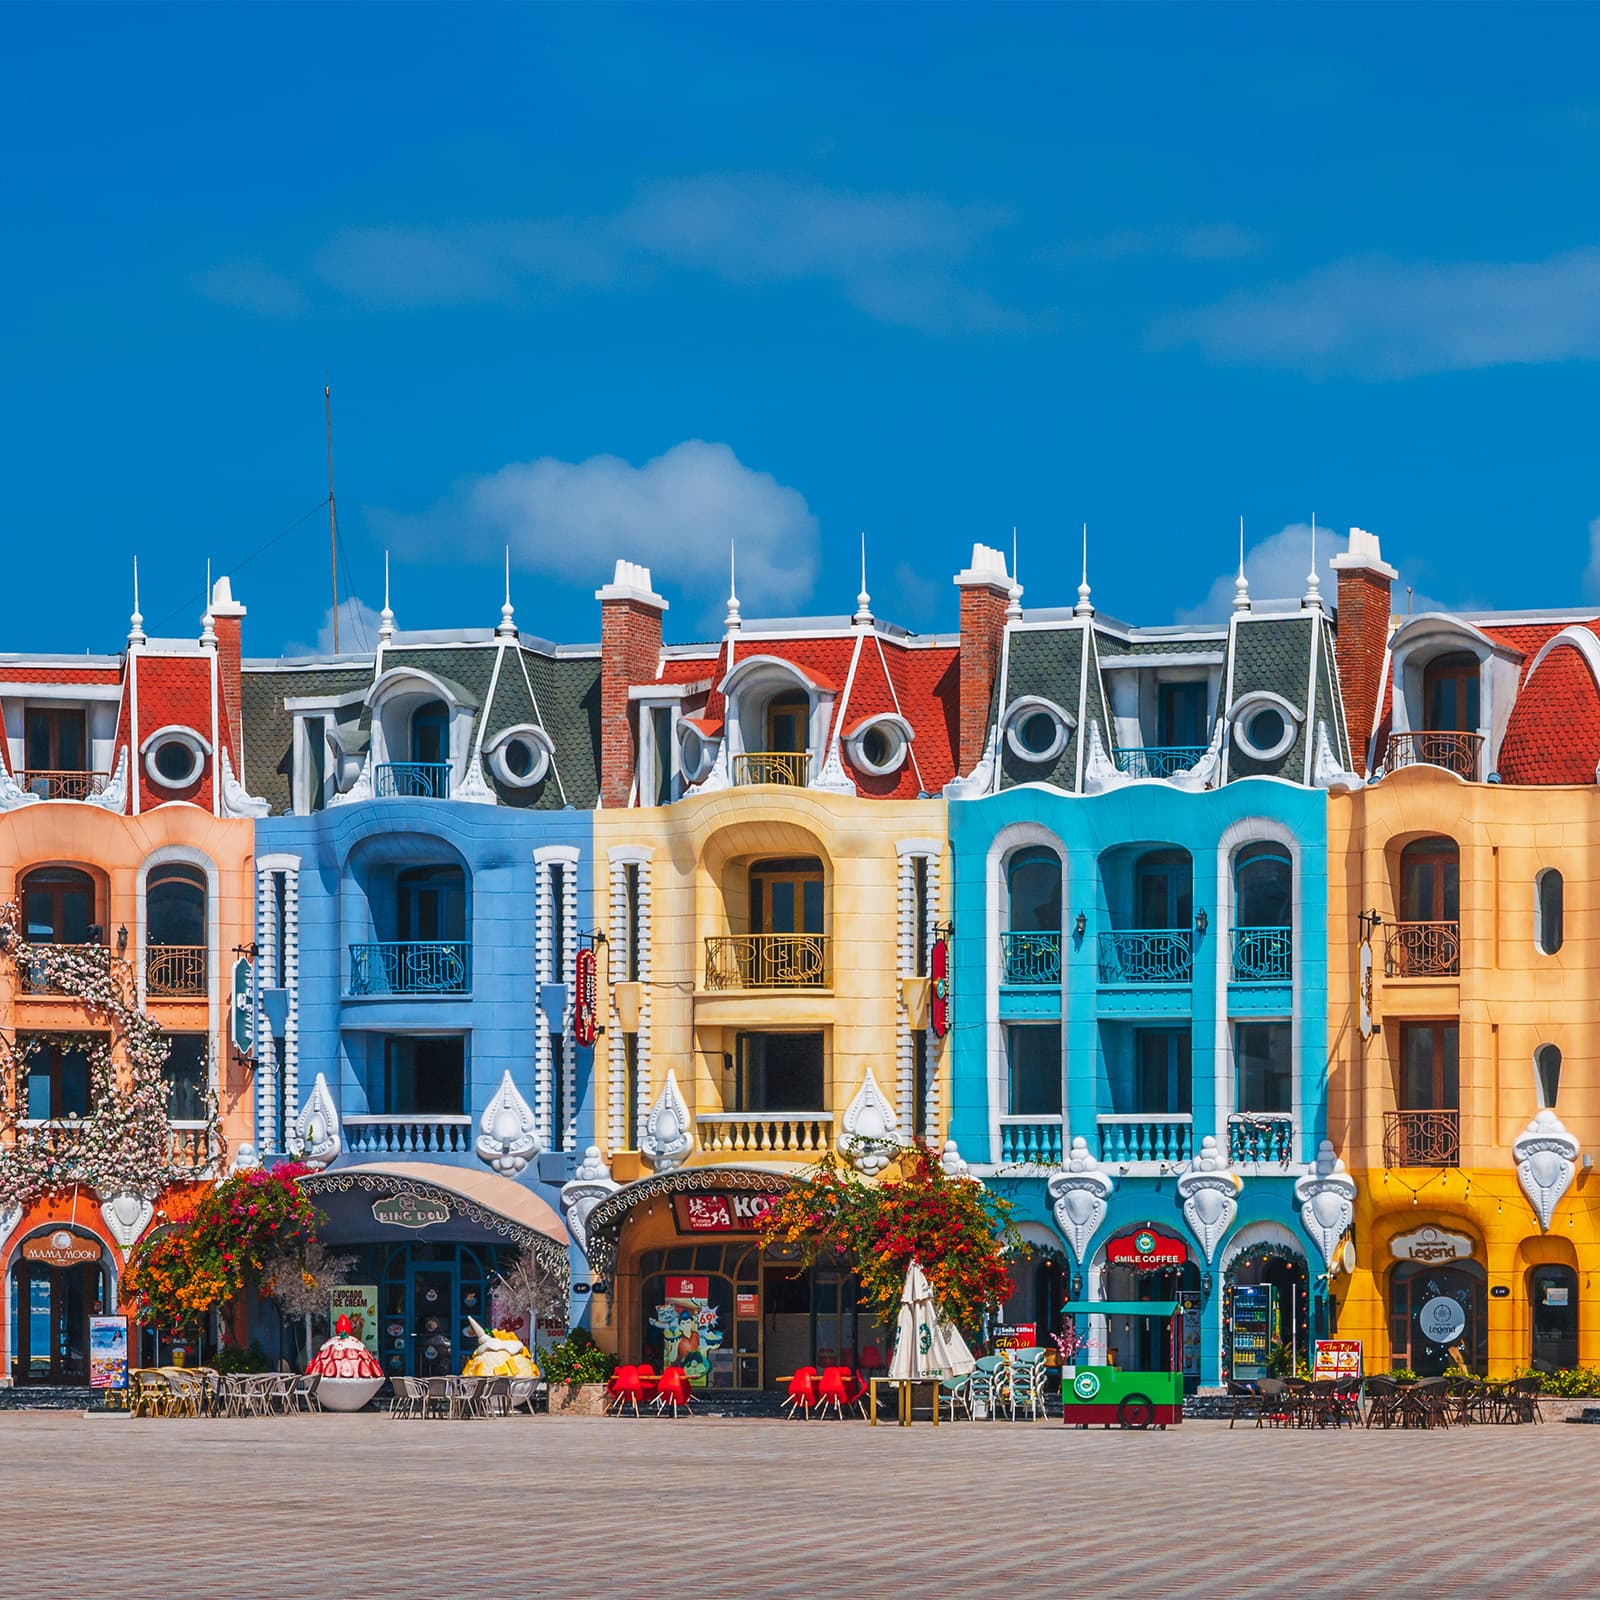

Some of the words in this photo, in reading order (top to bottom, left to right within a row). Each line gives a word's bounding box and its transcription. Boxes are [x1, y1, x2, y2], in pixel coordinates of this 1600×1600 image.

[379, 1212, 412, 1221] BING
[416, 1211, 445, 1220] DOU
[28, 1249, 63, 1259] MAMA
[64, 1250, 96, 1259] MOON
[1408, 1245, 1456, 1260] Legend
[1114, 1255, 1142, 1263] SMILE
[1142, 1255, 1179, 1263] COFFEE
[333, 1299, 343, 1307] ICE
[344, 1299, 368, 1307] CREAM
